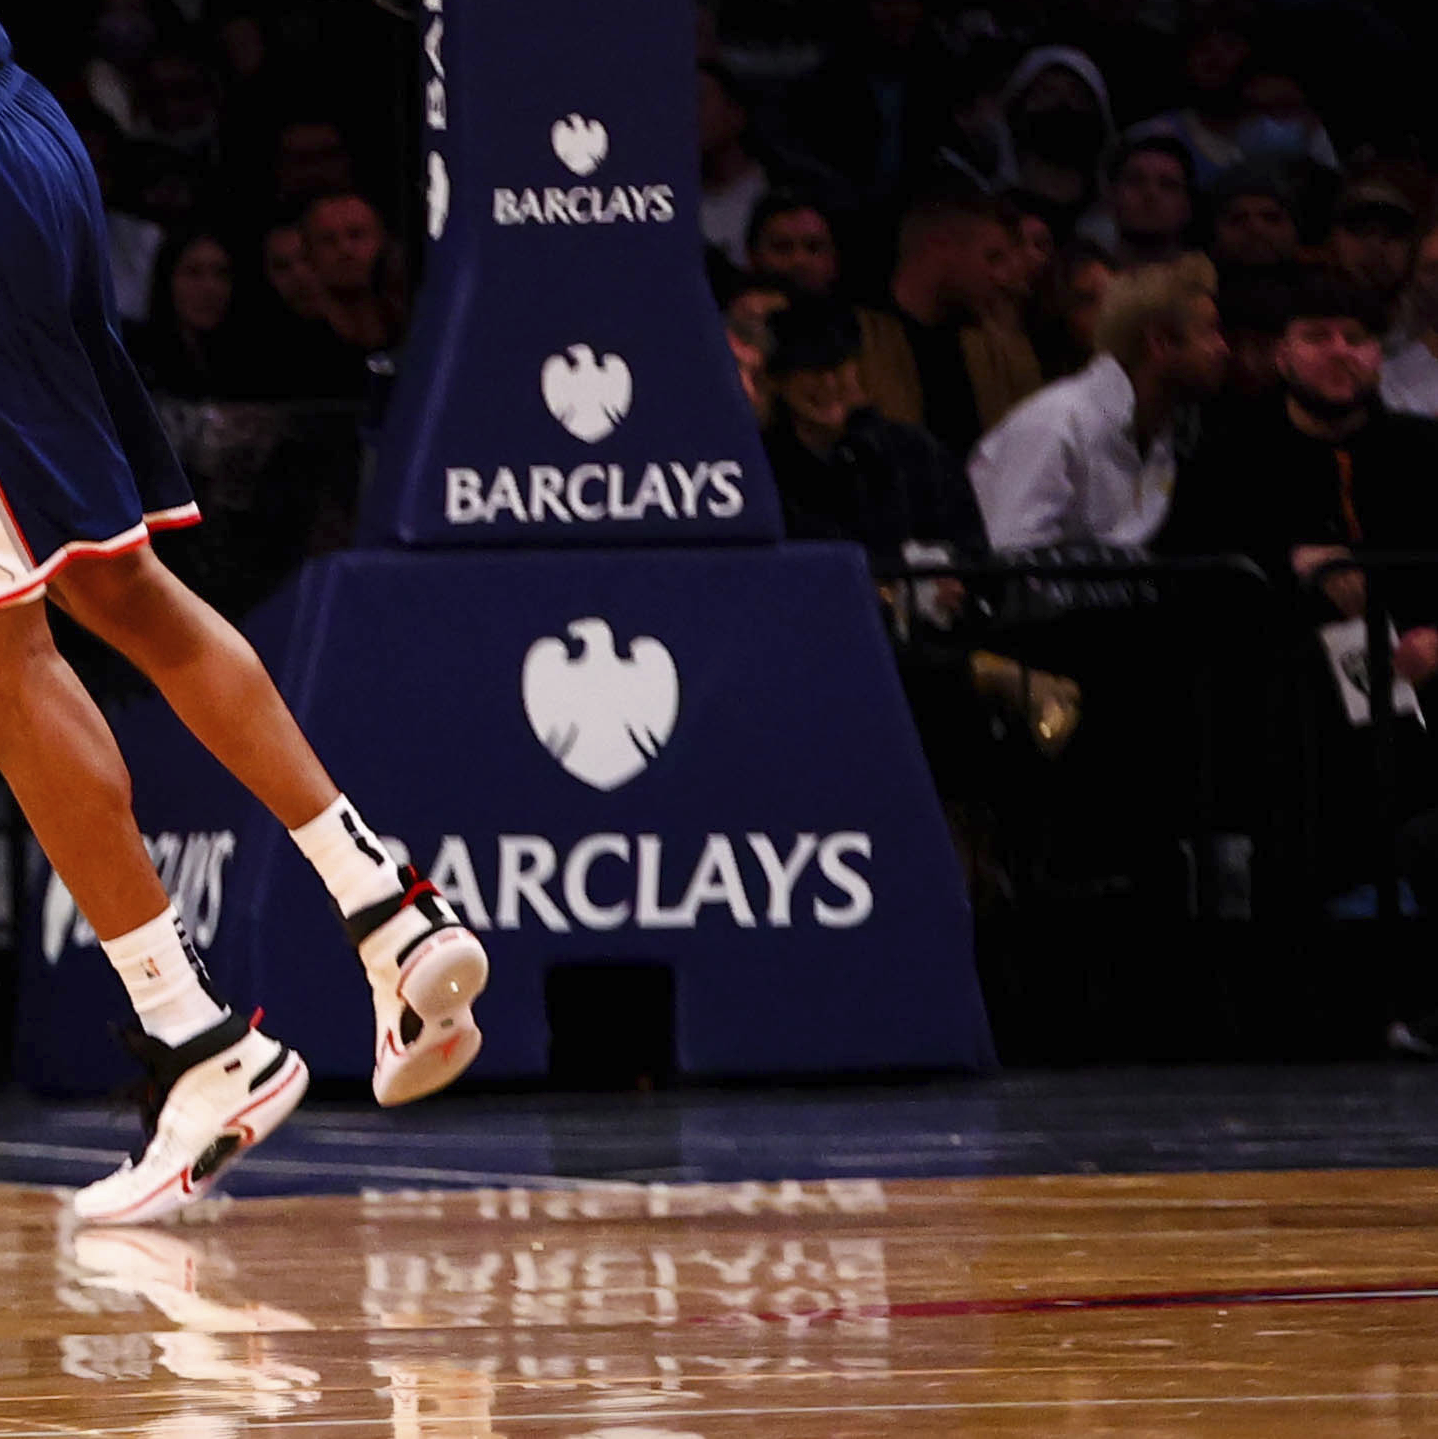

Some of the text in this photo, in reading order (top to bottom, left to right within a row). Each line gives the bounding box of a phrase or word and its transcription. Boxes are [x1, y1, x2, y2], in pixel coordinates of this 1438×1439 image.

[492, 183, 675, 226] BARCLAYS
[444, 460, 745, 525] BARCLAYS
[385, 830, 875, 934] ARCLAYS
